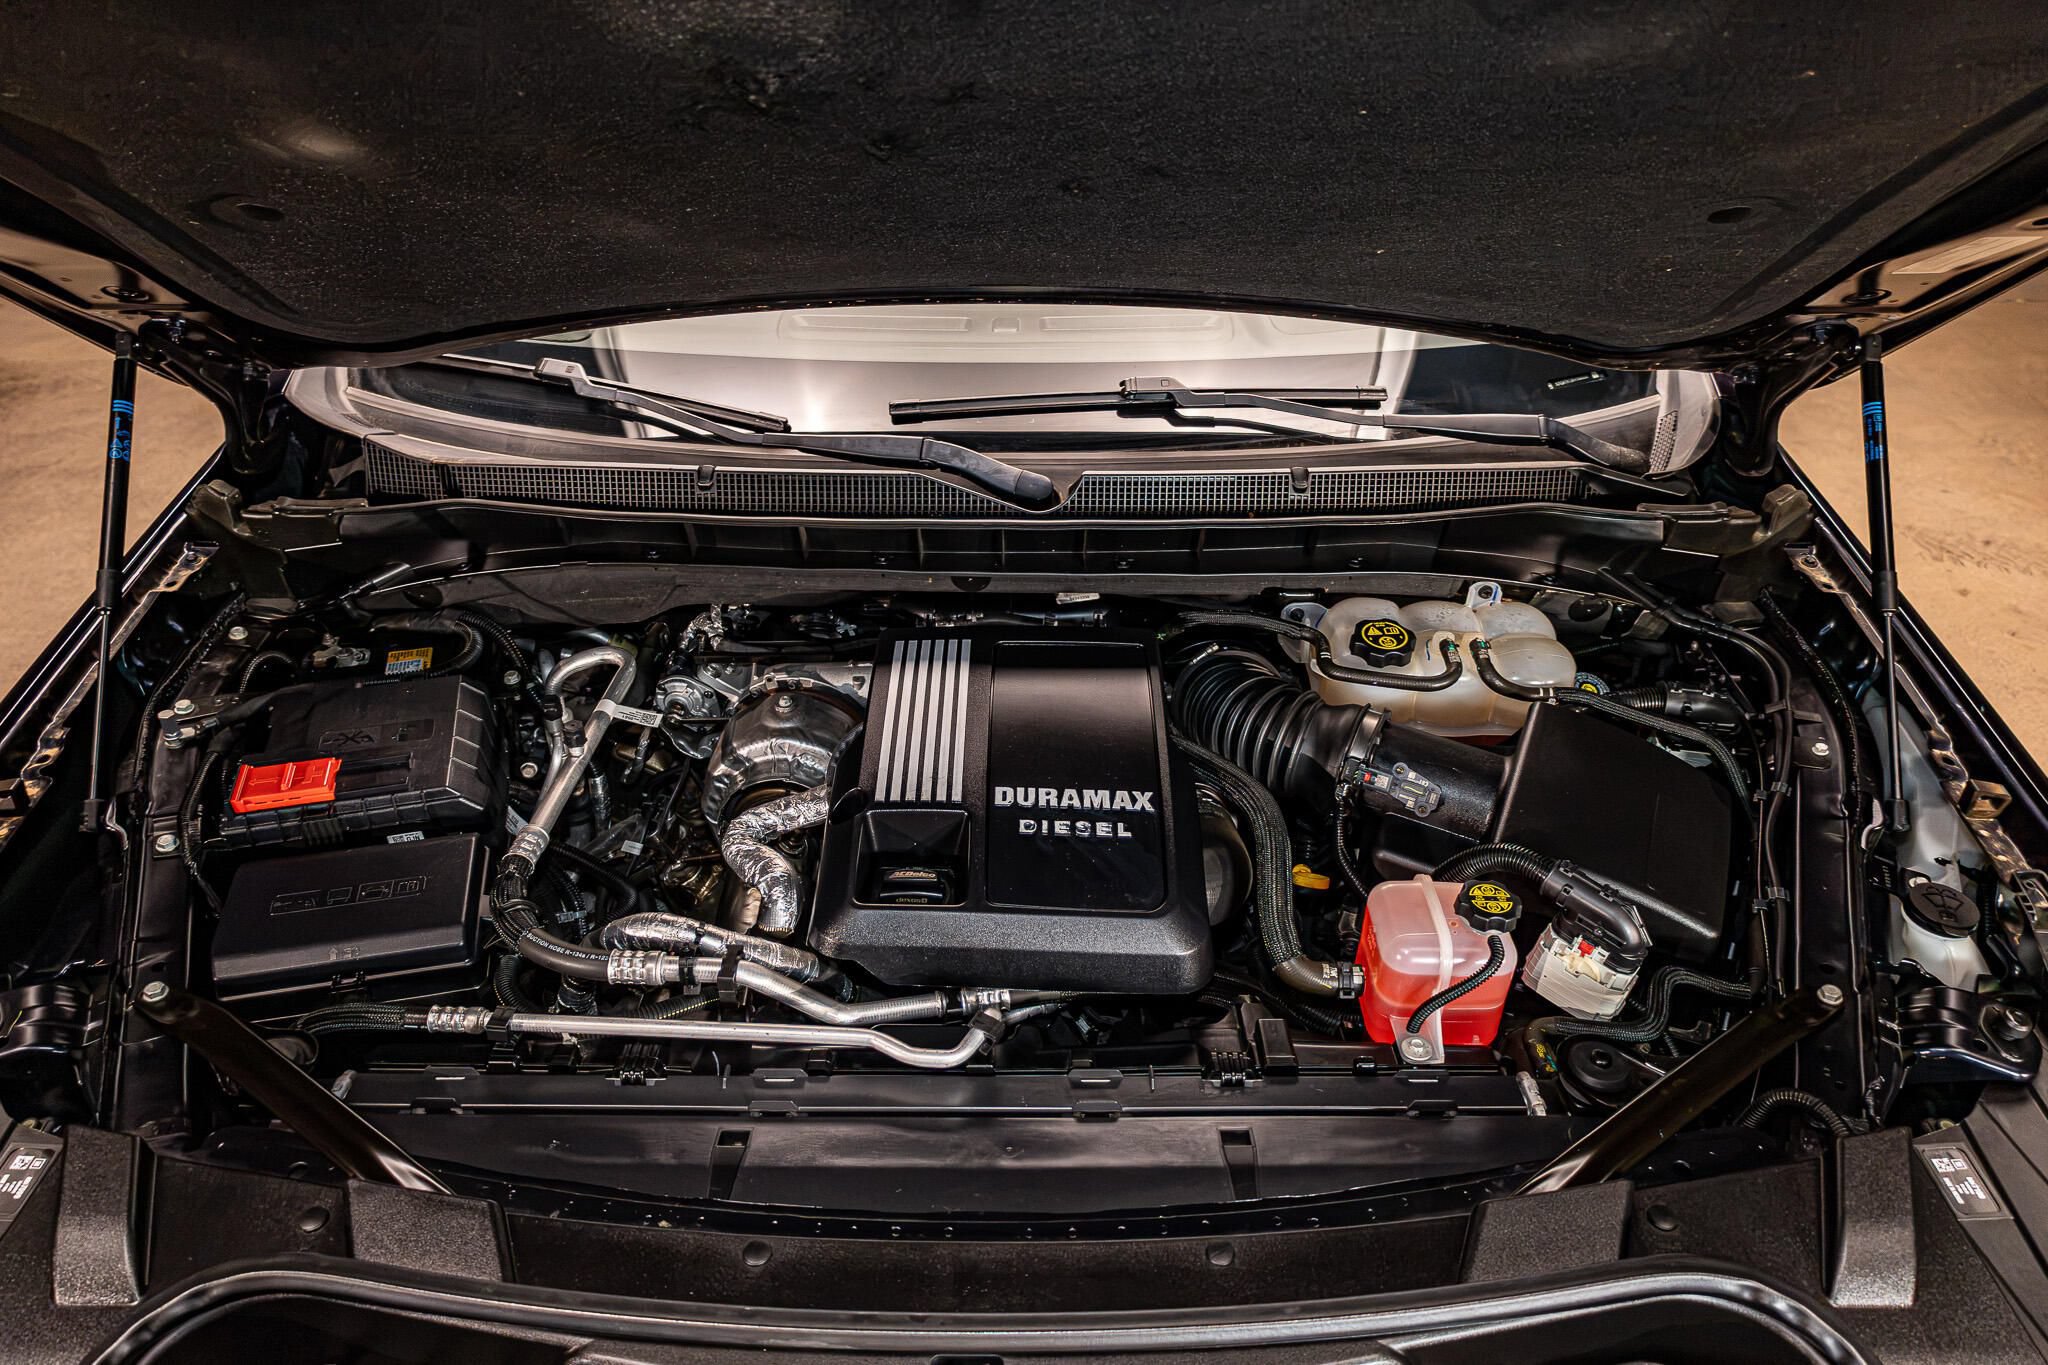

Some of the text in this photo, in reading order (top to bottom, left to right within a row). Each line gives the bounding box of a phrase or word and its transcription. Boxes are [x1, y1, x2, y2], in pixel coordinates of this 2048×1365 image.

[994, 786, 1155, 812] DURAMAX
[1019, 819, 1132, 837] DIESEL
[526, 932, 548, 948] SUCTION
[548, 944, 565, 954] HOSE
